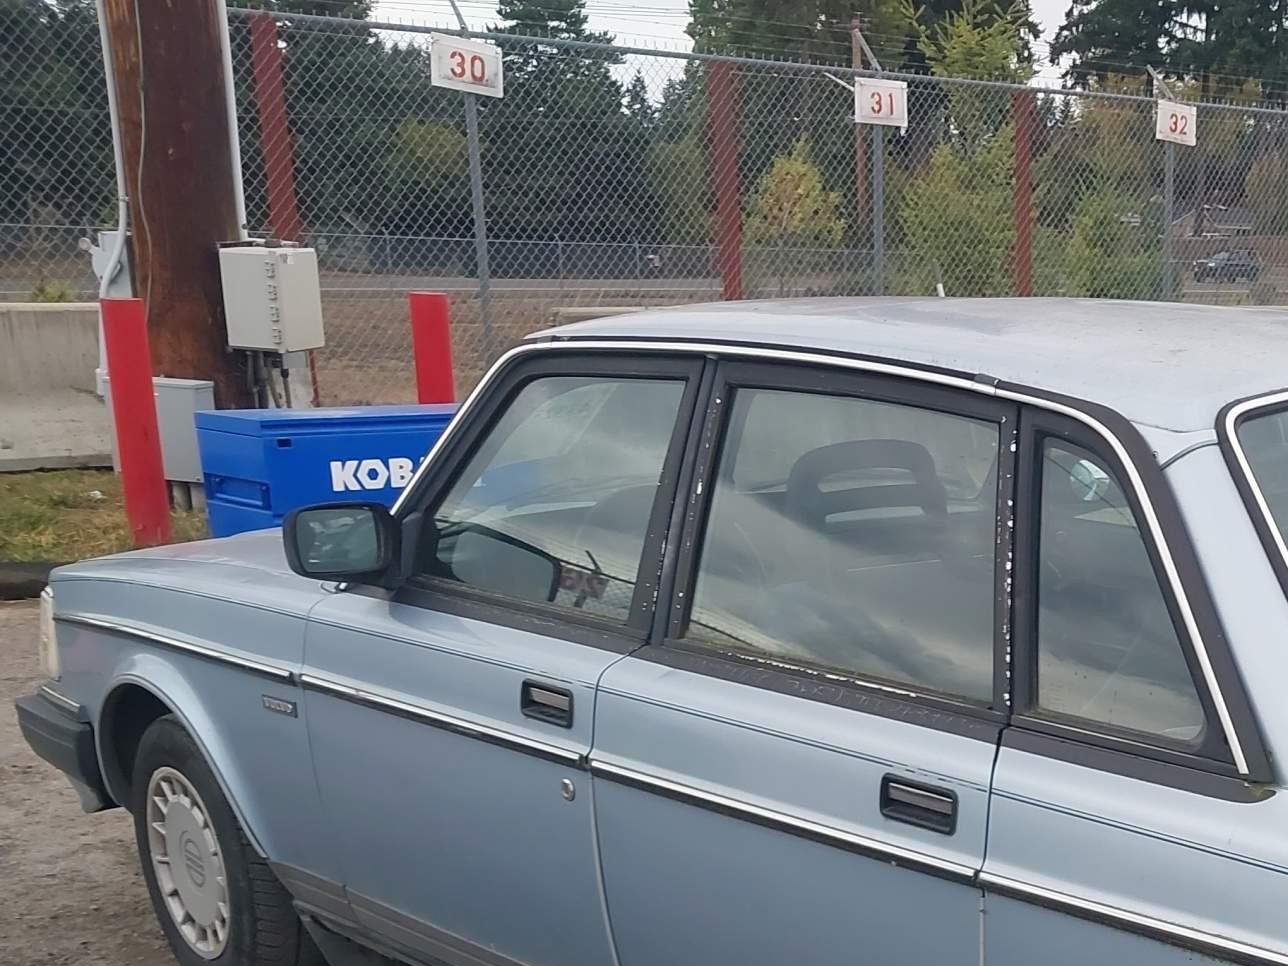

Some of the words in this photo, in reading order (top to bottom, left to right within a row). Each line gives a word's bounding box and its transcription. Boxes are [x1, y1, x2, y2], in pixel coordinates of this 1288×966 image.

[449, 50, 487, 83] 30
[870, 91, 894, 116] 31
[1168, 112, 1189, 136] 32
[329, 456, 425, 492] KOB
